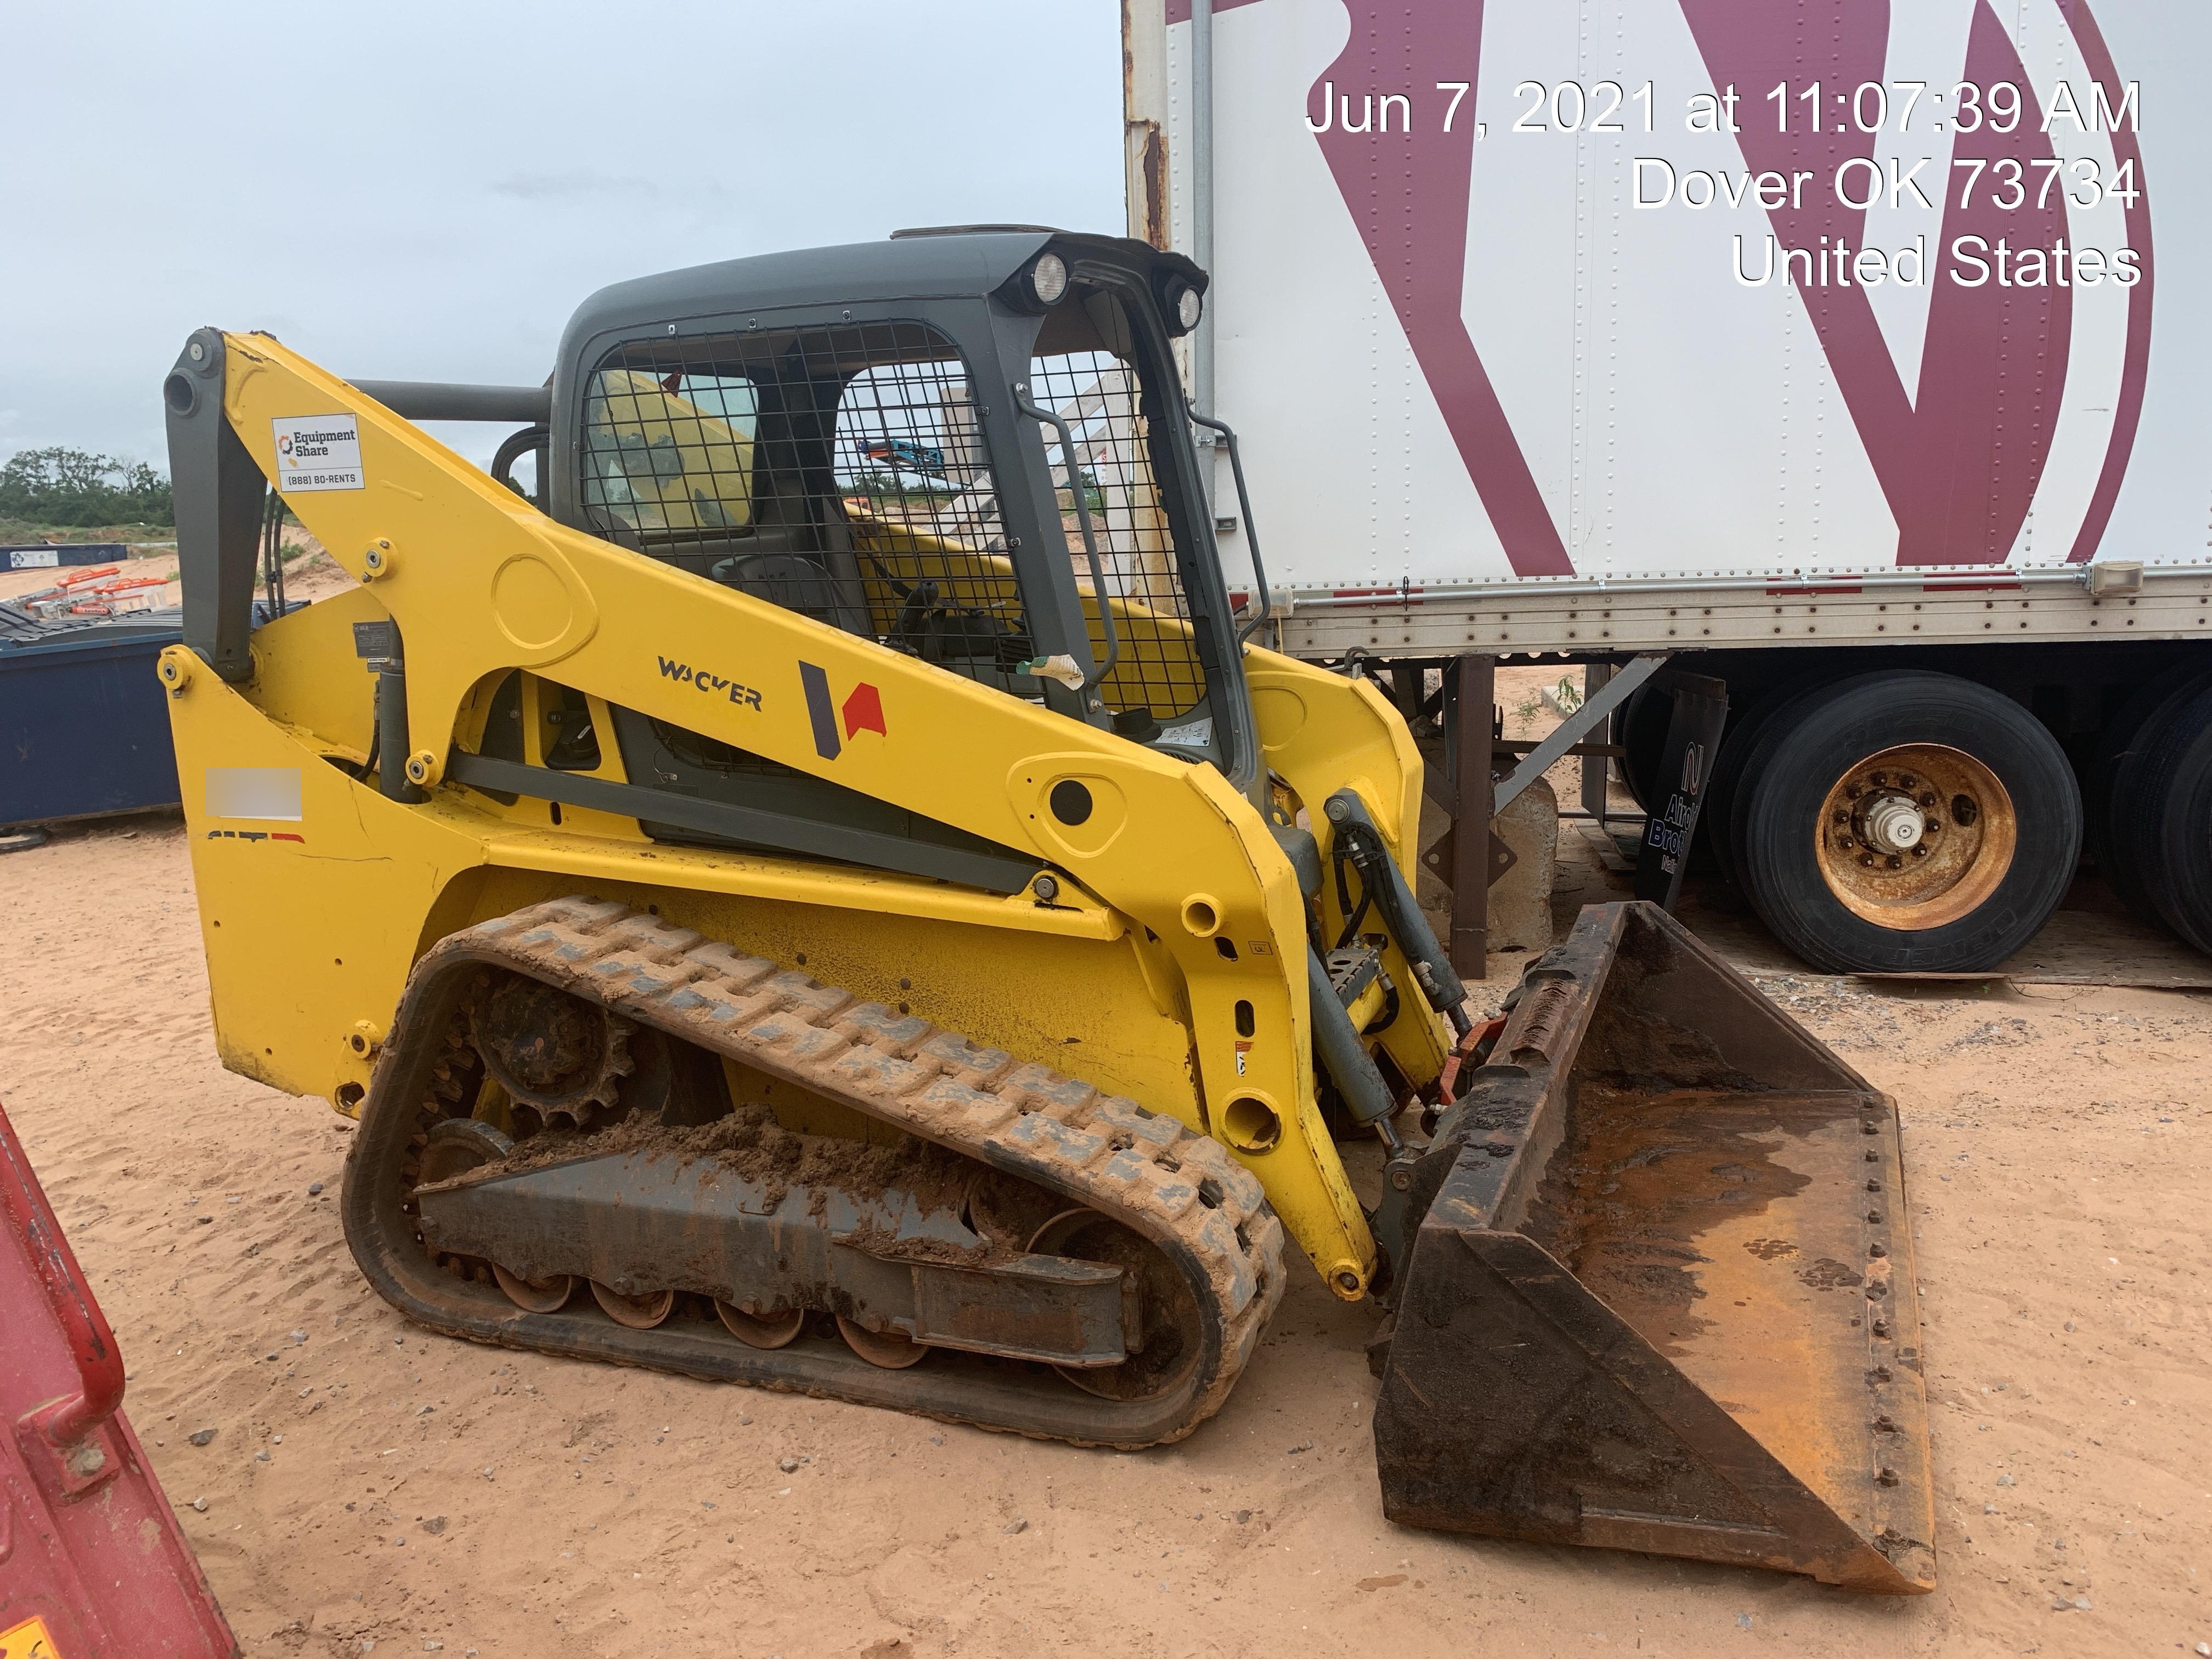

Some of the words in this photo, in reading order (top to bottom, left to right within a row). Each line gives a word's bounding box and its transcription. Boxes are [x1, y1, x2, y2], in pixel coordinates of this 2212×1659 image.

[294, 430, 356, 445] Equipment
[296, 445, 329, 457] Share
[288, 476, 312, 486] (888)
[314, 474, 356, 484] 80-RENTS
